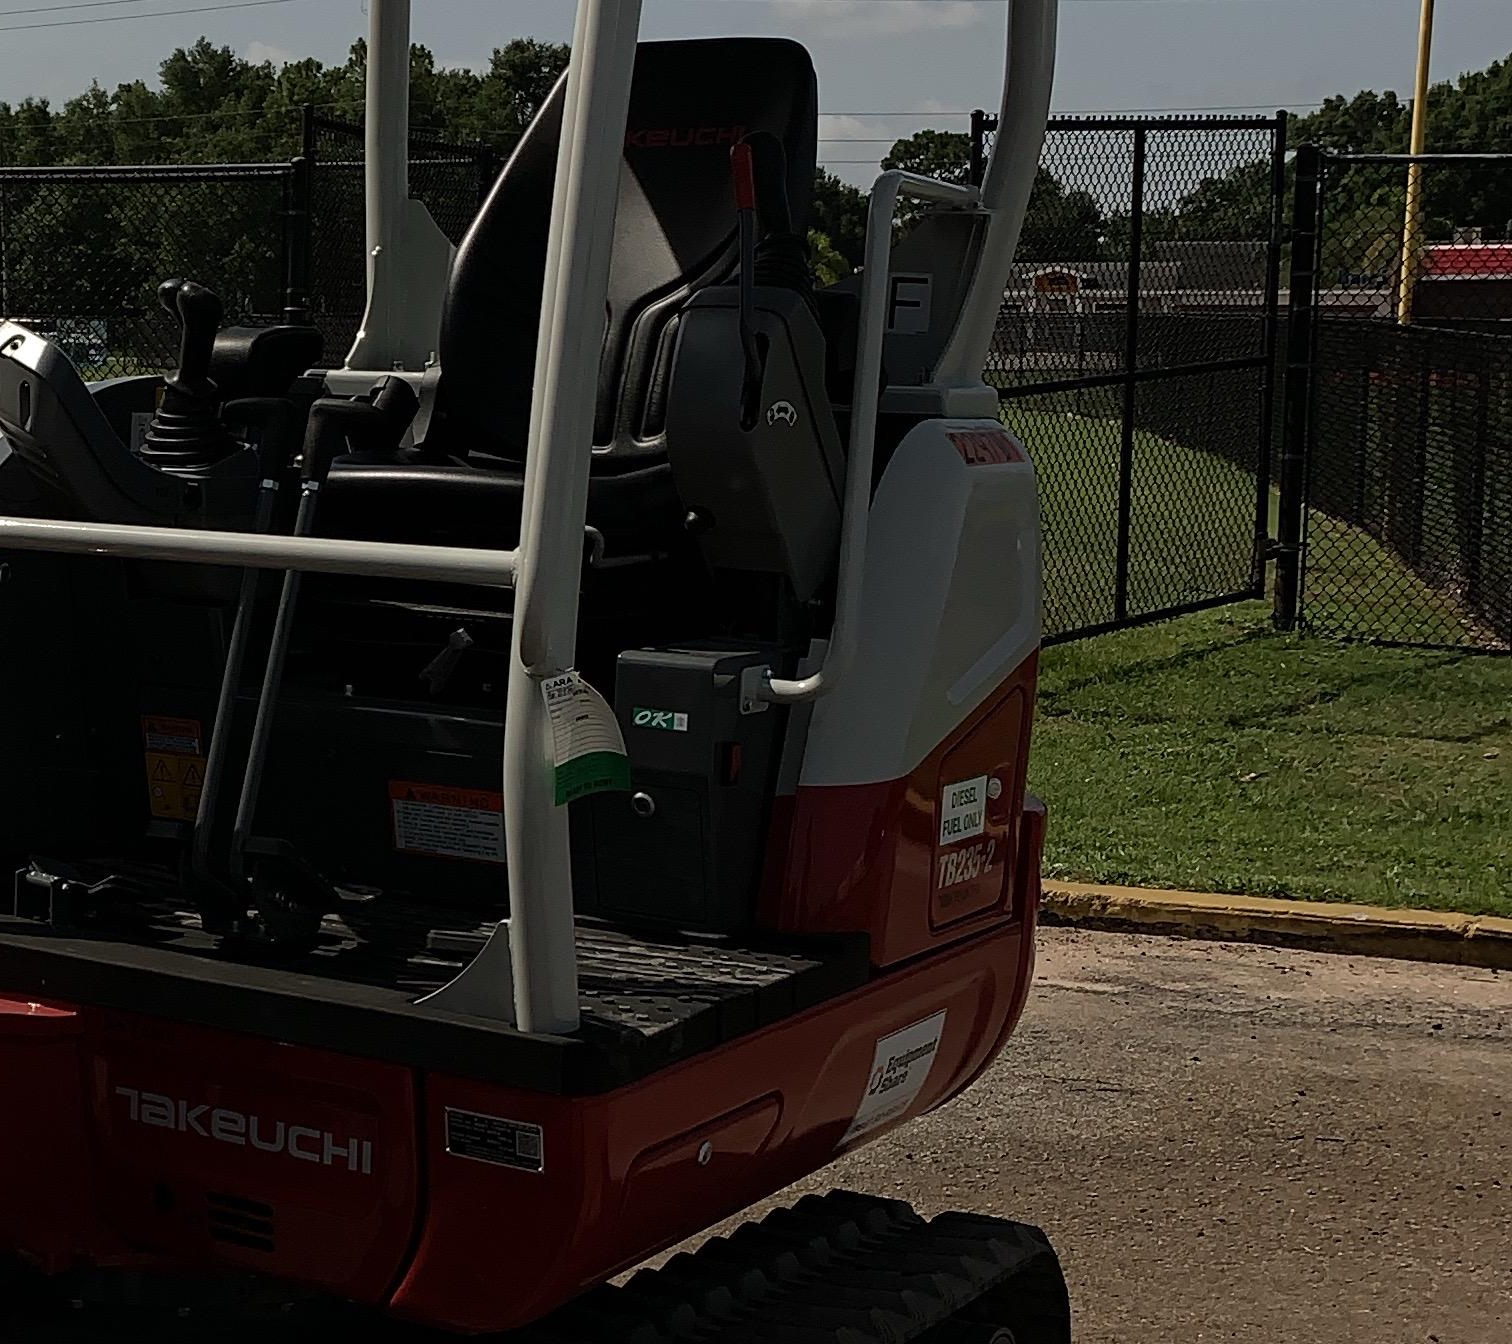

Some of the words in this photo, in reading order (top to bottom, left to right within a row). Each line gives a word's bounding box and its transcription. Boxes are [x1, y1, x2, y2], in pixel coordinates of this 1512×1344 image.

[634, 710, 673, 728] OK
[951, 786, 978, 809] DIESEL
[943, 816, 962, 836] FUEL
[964, 809, 983, 831] ONLY
[938, 839, 996, 889] TB235-2
[115, 1086, 372, 1175] TAKEUCHI
